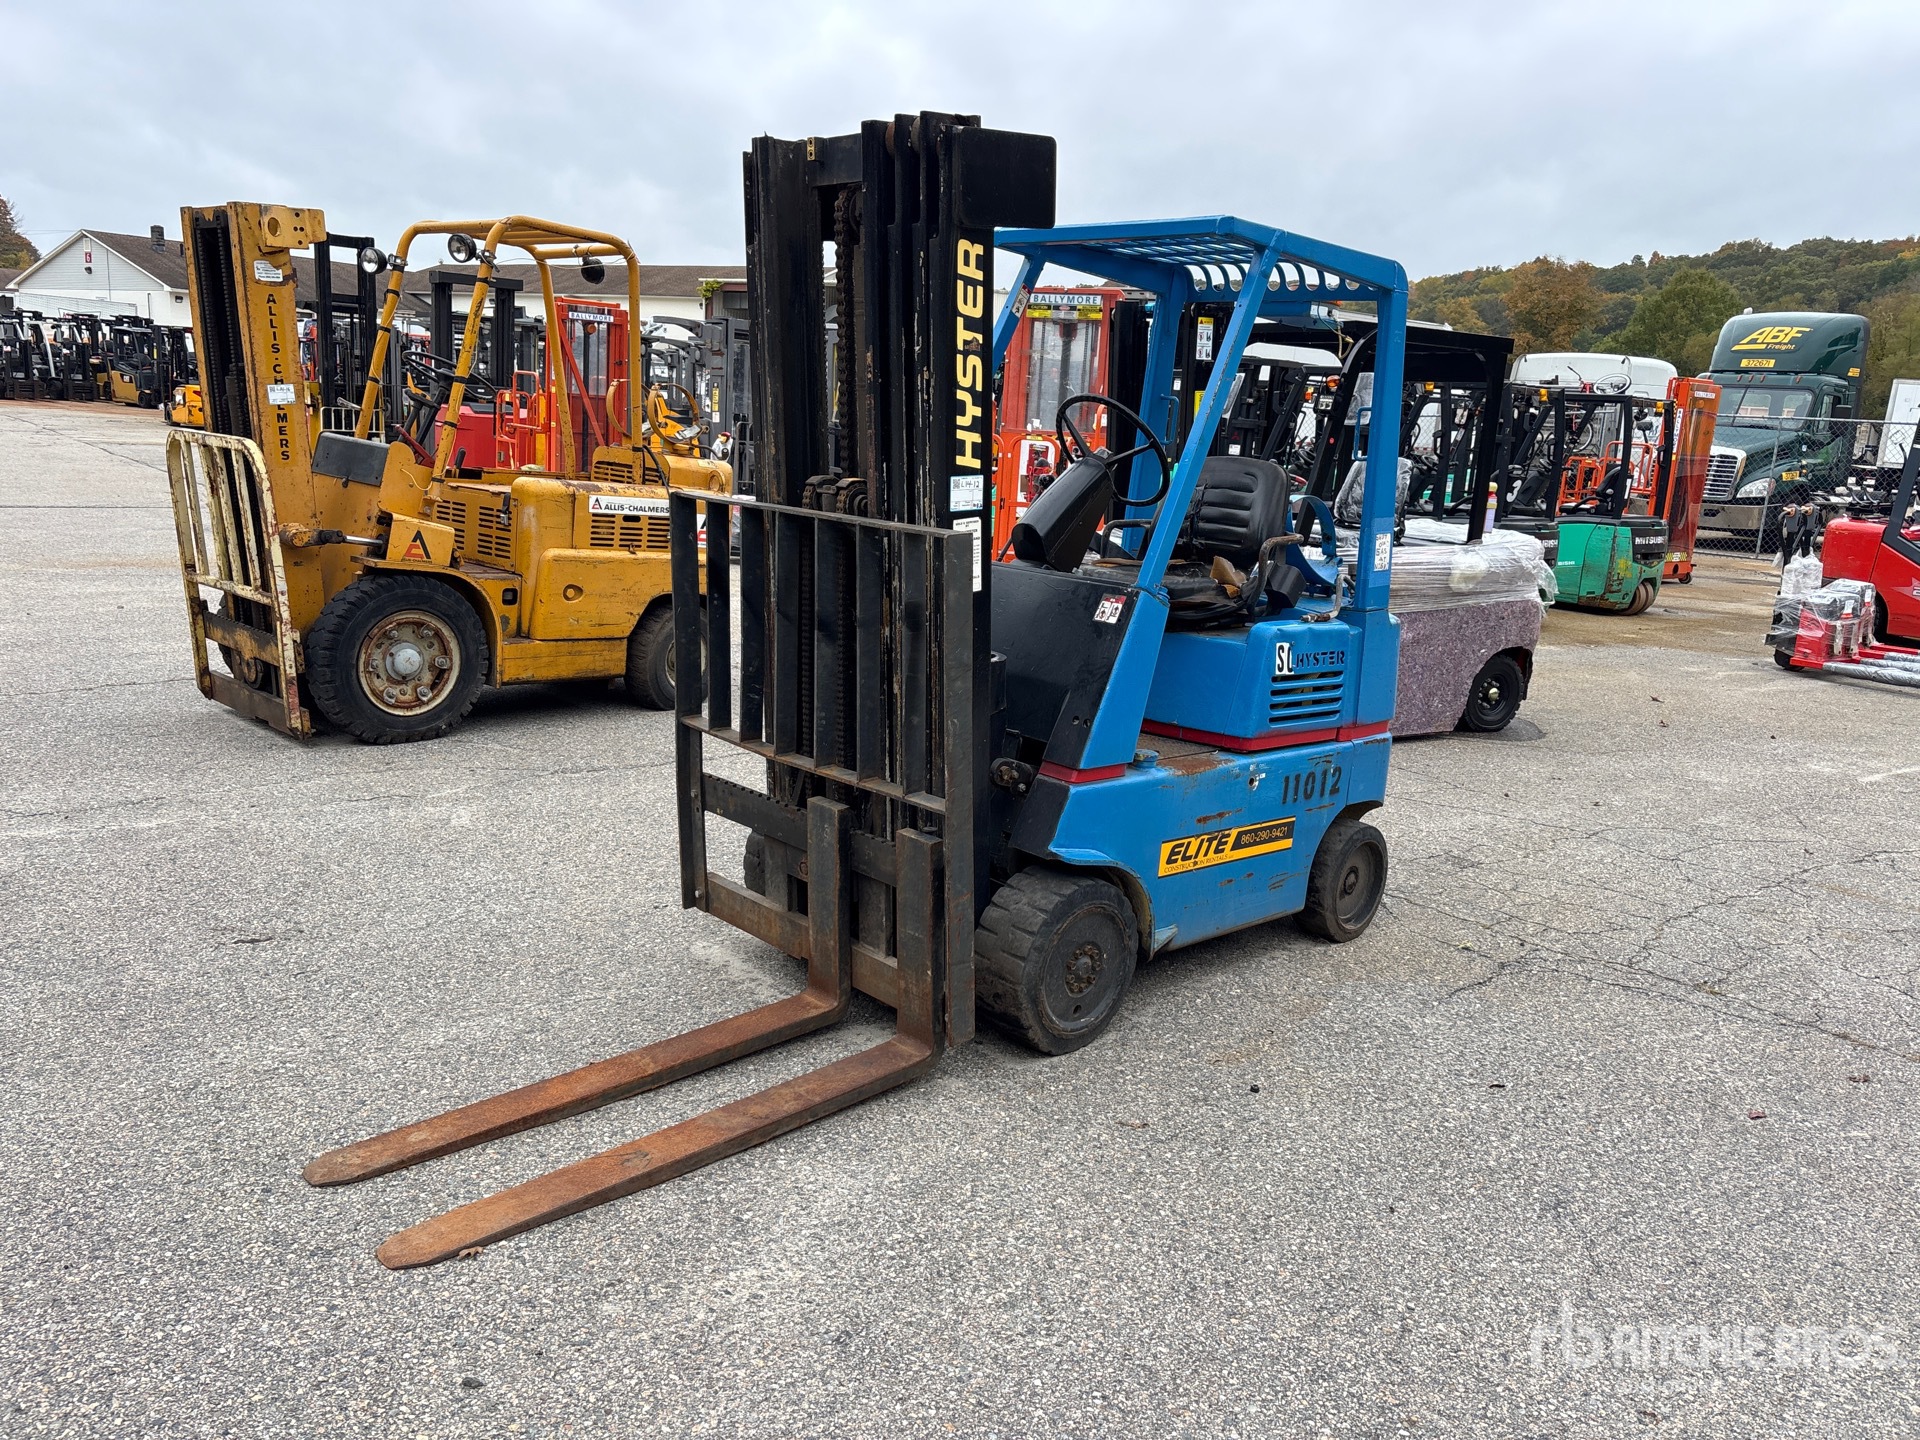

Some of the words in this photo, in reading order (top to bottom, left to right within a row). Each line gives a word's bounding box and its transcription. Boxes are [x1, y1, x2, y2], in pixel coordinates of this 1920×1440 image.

[1033, 294, 1098, 304] BALLYMORE
[571, 312, 612, 322] BALLYMORE
[1739, 326, 1811, 344] ABF
[956, 238, 983, 469] HYSTER
[1767, 343, 1796, 351] Freight
[266, 293, 290, 461] ALLIS-CHLMERS
[1506, 479, 1522, 503] 3
[604, 503, 670, 513] ALLIS-CHALMERS
[1296, 650, 1345, 668] HYSTER
[1282, 766, 1342, 804] 11012
[1240, 826, 1288, 845] 860-290-9421
[1165, 832, 1232, 866] ELITE
[1206, 854, 1229, 865] RENTALS
